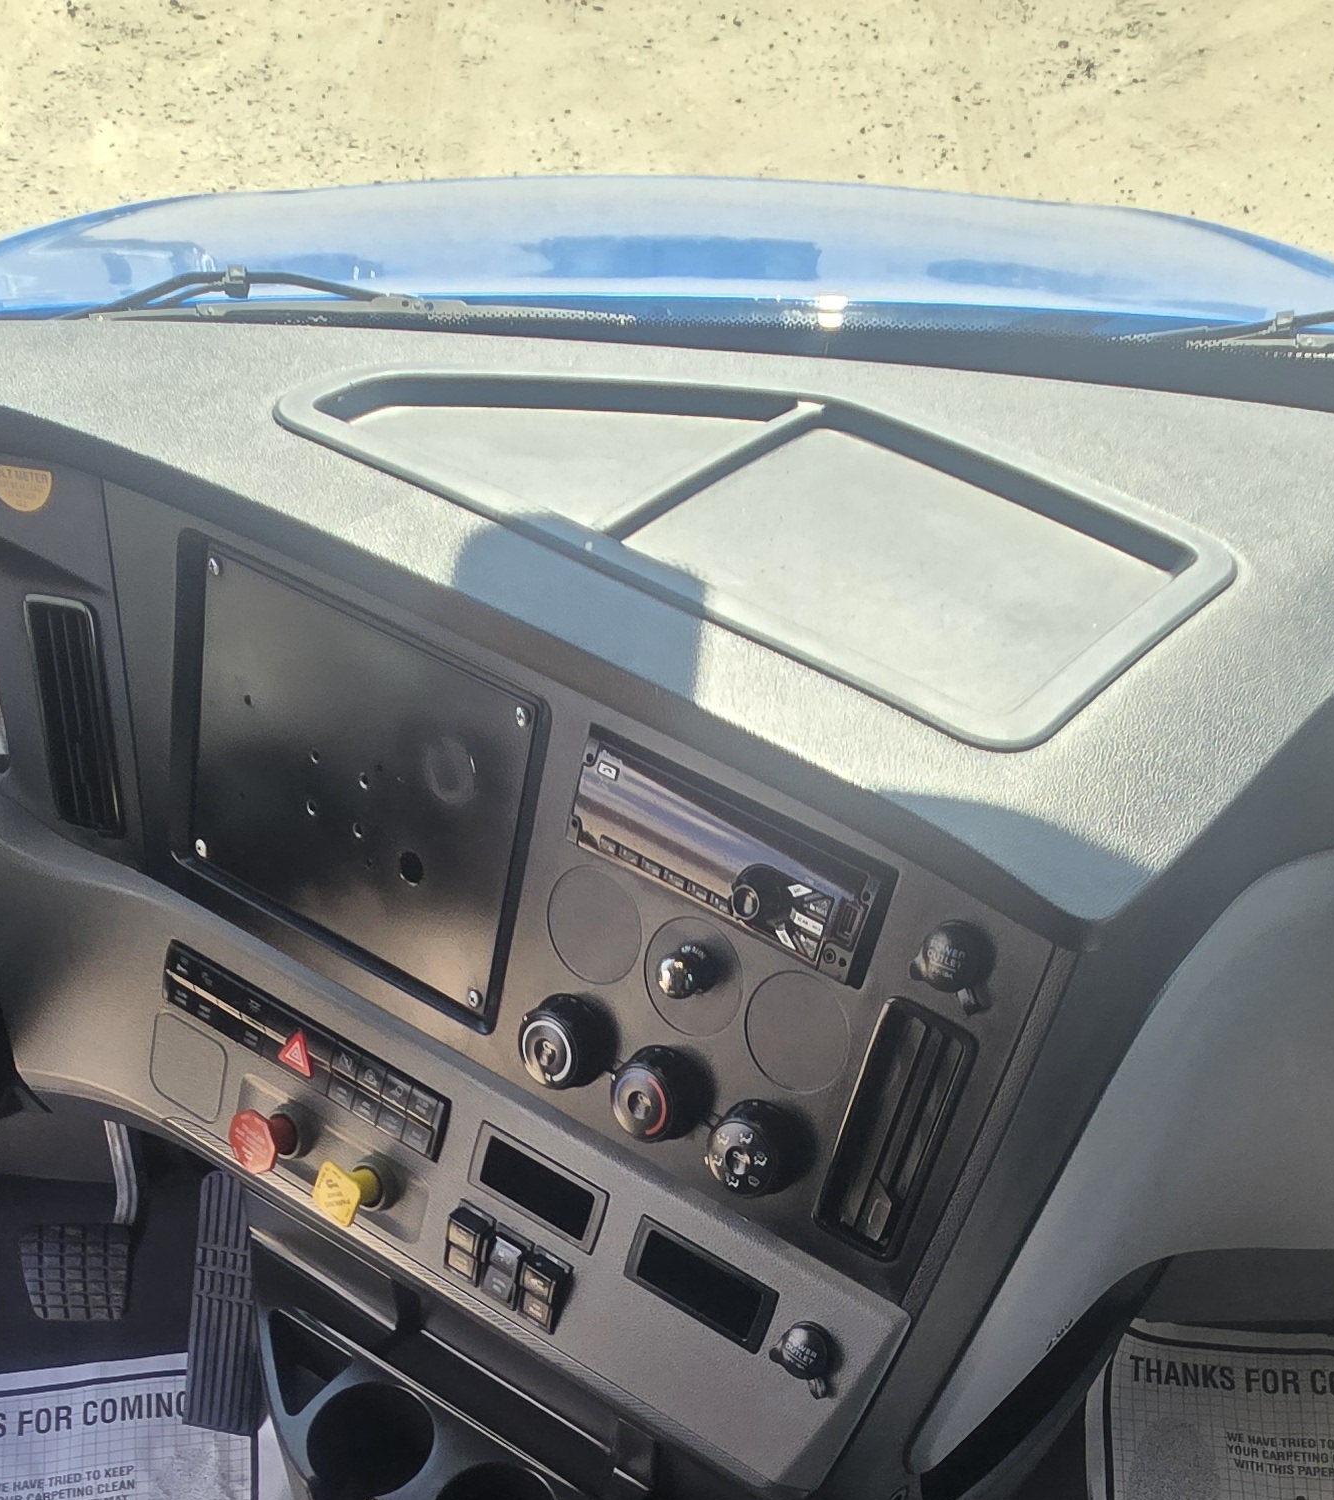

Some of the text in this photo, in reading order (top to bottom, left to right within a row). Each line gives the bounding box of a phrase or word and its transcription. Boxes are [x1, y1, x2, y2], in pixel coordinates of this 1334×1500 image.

[785, 1342, 814, 1365] OUTLET
[1129, 1355, 1236, 1391] THANKS
[1245, 1367, 1300, 1395] FOR
[17, 1405, 72, 1436] FOR
[1227, 1431, 1245, 1443] WE
[1248, 1435, 1277, 1447] HAVE
[1280, 1437, 1316, 1449] TRIED
[1320, 1438, 1334, 1450] TO
[1226, 1444, 1259, 1458] YOUR
[1262, 1450, 1329, 1463] CARPETING
[1233, 1458, 1264, 1472] WITH
[1267, 1463, 1294, 1475] THIS
[13, 1478, 44, 1491] HAVE
[48, 1473, 82, 1487] TRIED
[85, 1469, 101, 1481] TO
[104, 1465, 135, 1478] KEEP
[97, 1479, 136, 1494] CLEAN
